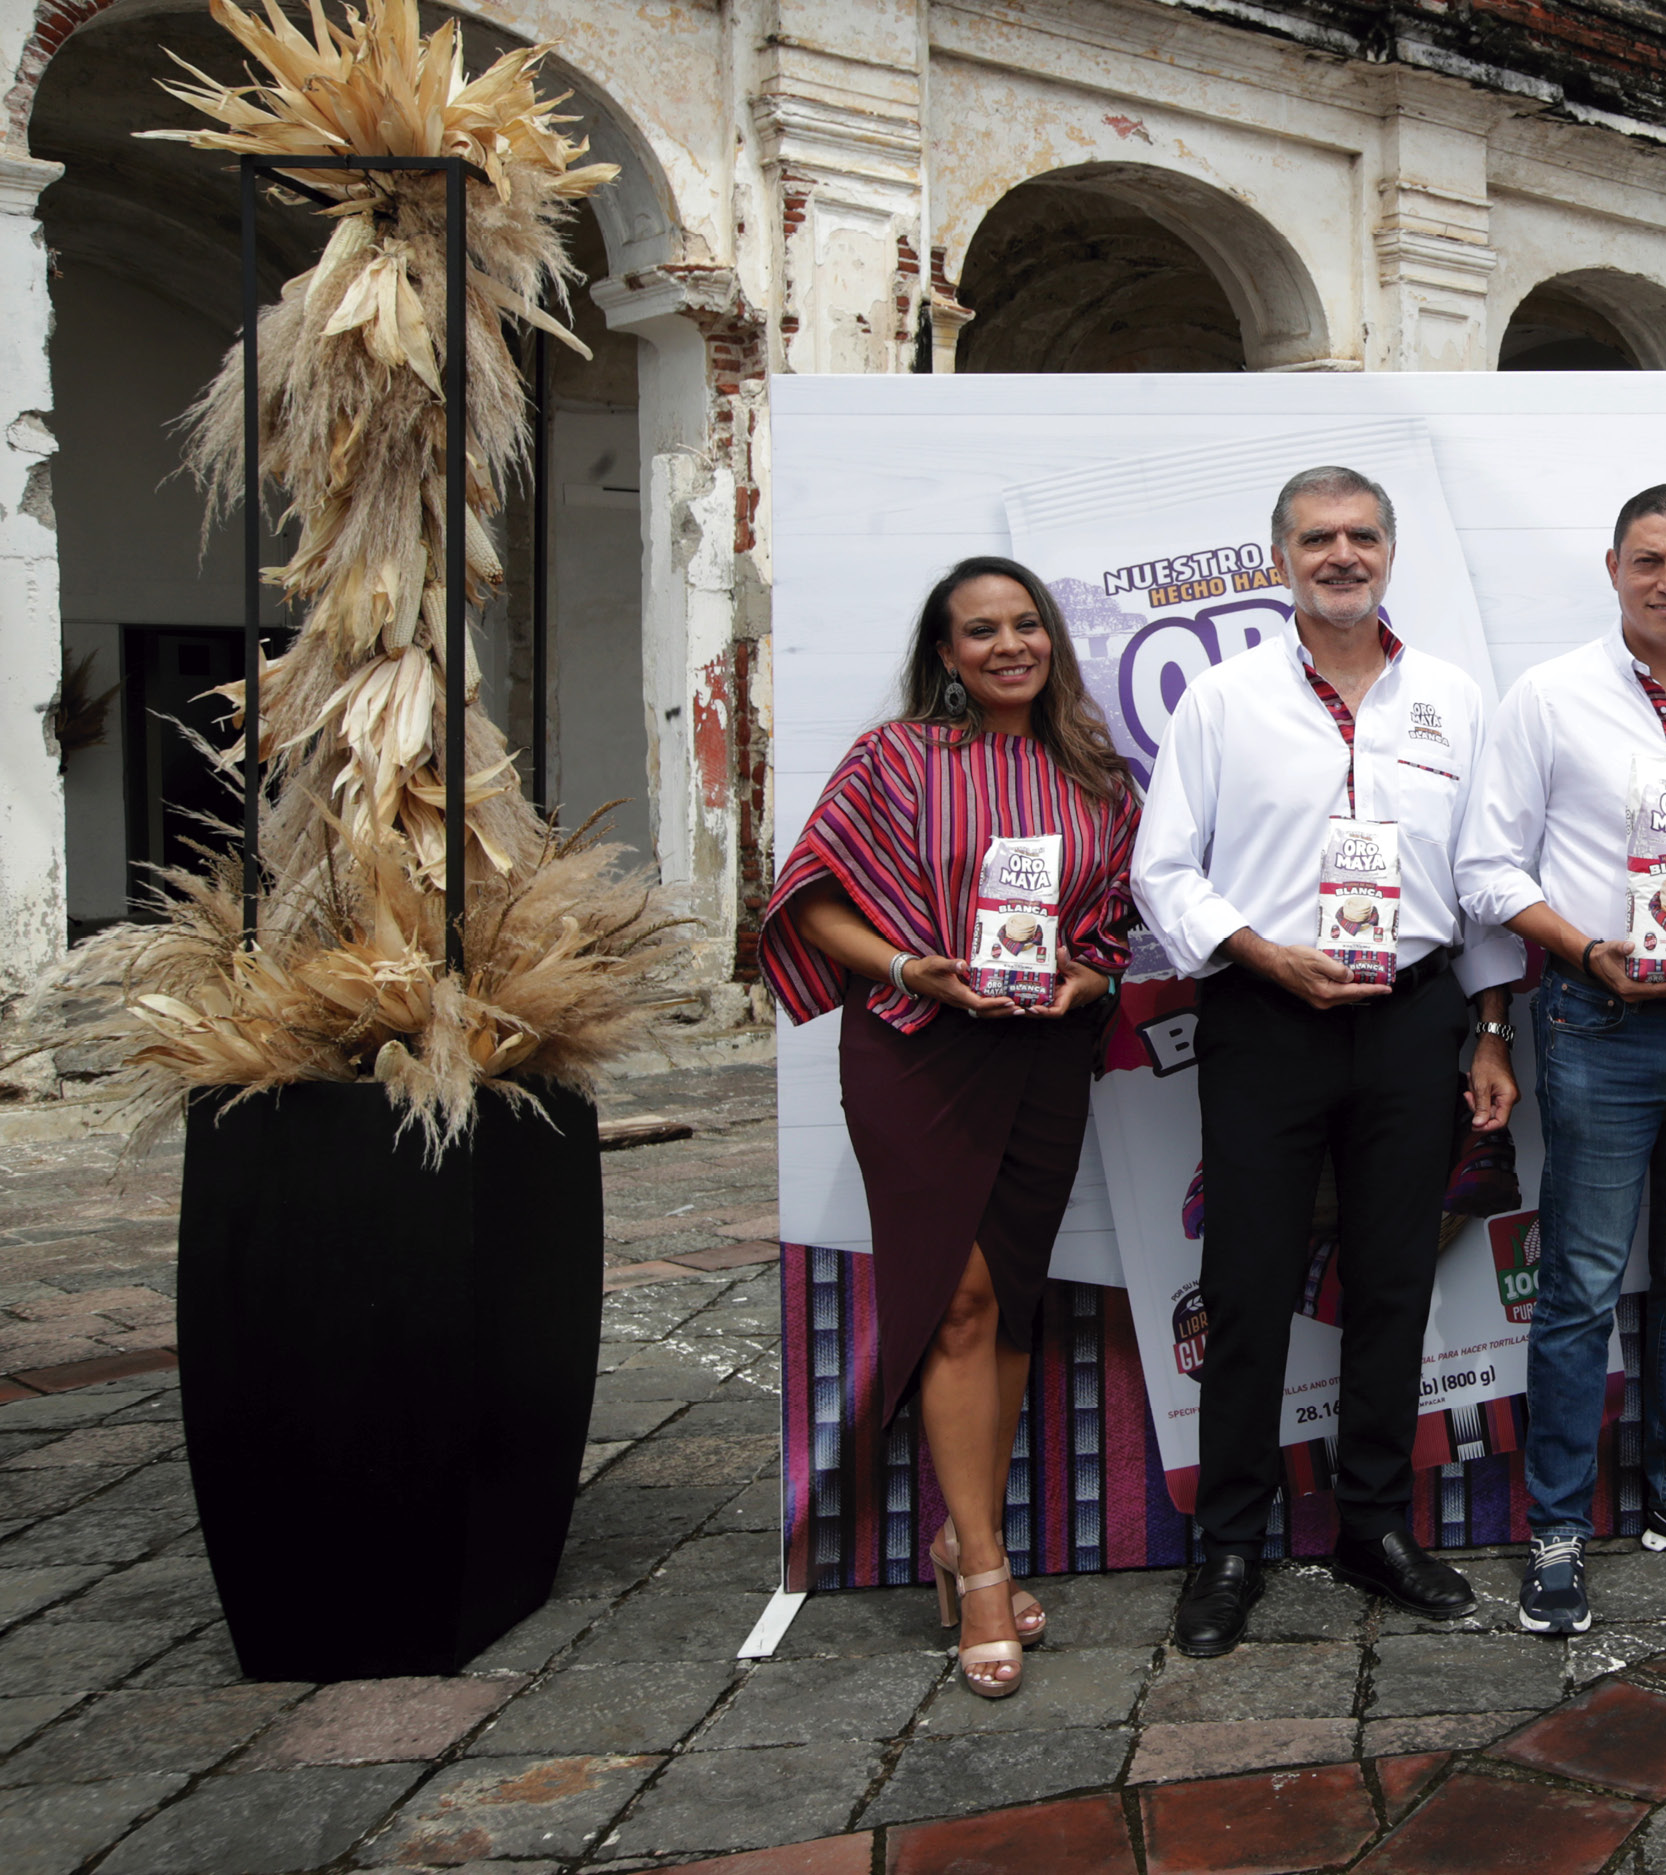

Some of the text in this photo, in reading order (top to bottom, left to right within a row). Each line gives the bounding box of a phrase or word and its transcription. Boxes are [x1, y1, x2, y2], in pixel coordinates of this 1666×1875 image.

[1104, 543, 1263, 596] NUESTRO
[1148, 566, 1285, 608] HECHO HAR
[1413, 702, 1435, 716] ORO
[1410, 712, 1442, 727] MAYA
[1343, 839, 1379, 857] ORO
[1009, 854, 1045, 873] ORO
[1334, 852, 1386, 872] MAYA
[999, 867, 1051, 891] MAYA
[1335, 886, 1383, 899] BLANCA
[998, 904, 1048, 917] BLANCA
[1171, 1288, 1184, 1302] POR
[1512, 1302, 1536, 1321] PUR
[1178, 1311, 1208, 1339] LIBR
[1438, 1350, 1458, 1361] PARA
[1460, 1344, 1487, 1356] HACER
[1310, 1380, 1327, 1390] AND
[1442, 1371, 1476, 1392] (800
[1481, 1365, 1496, 1386] g)
